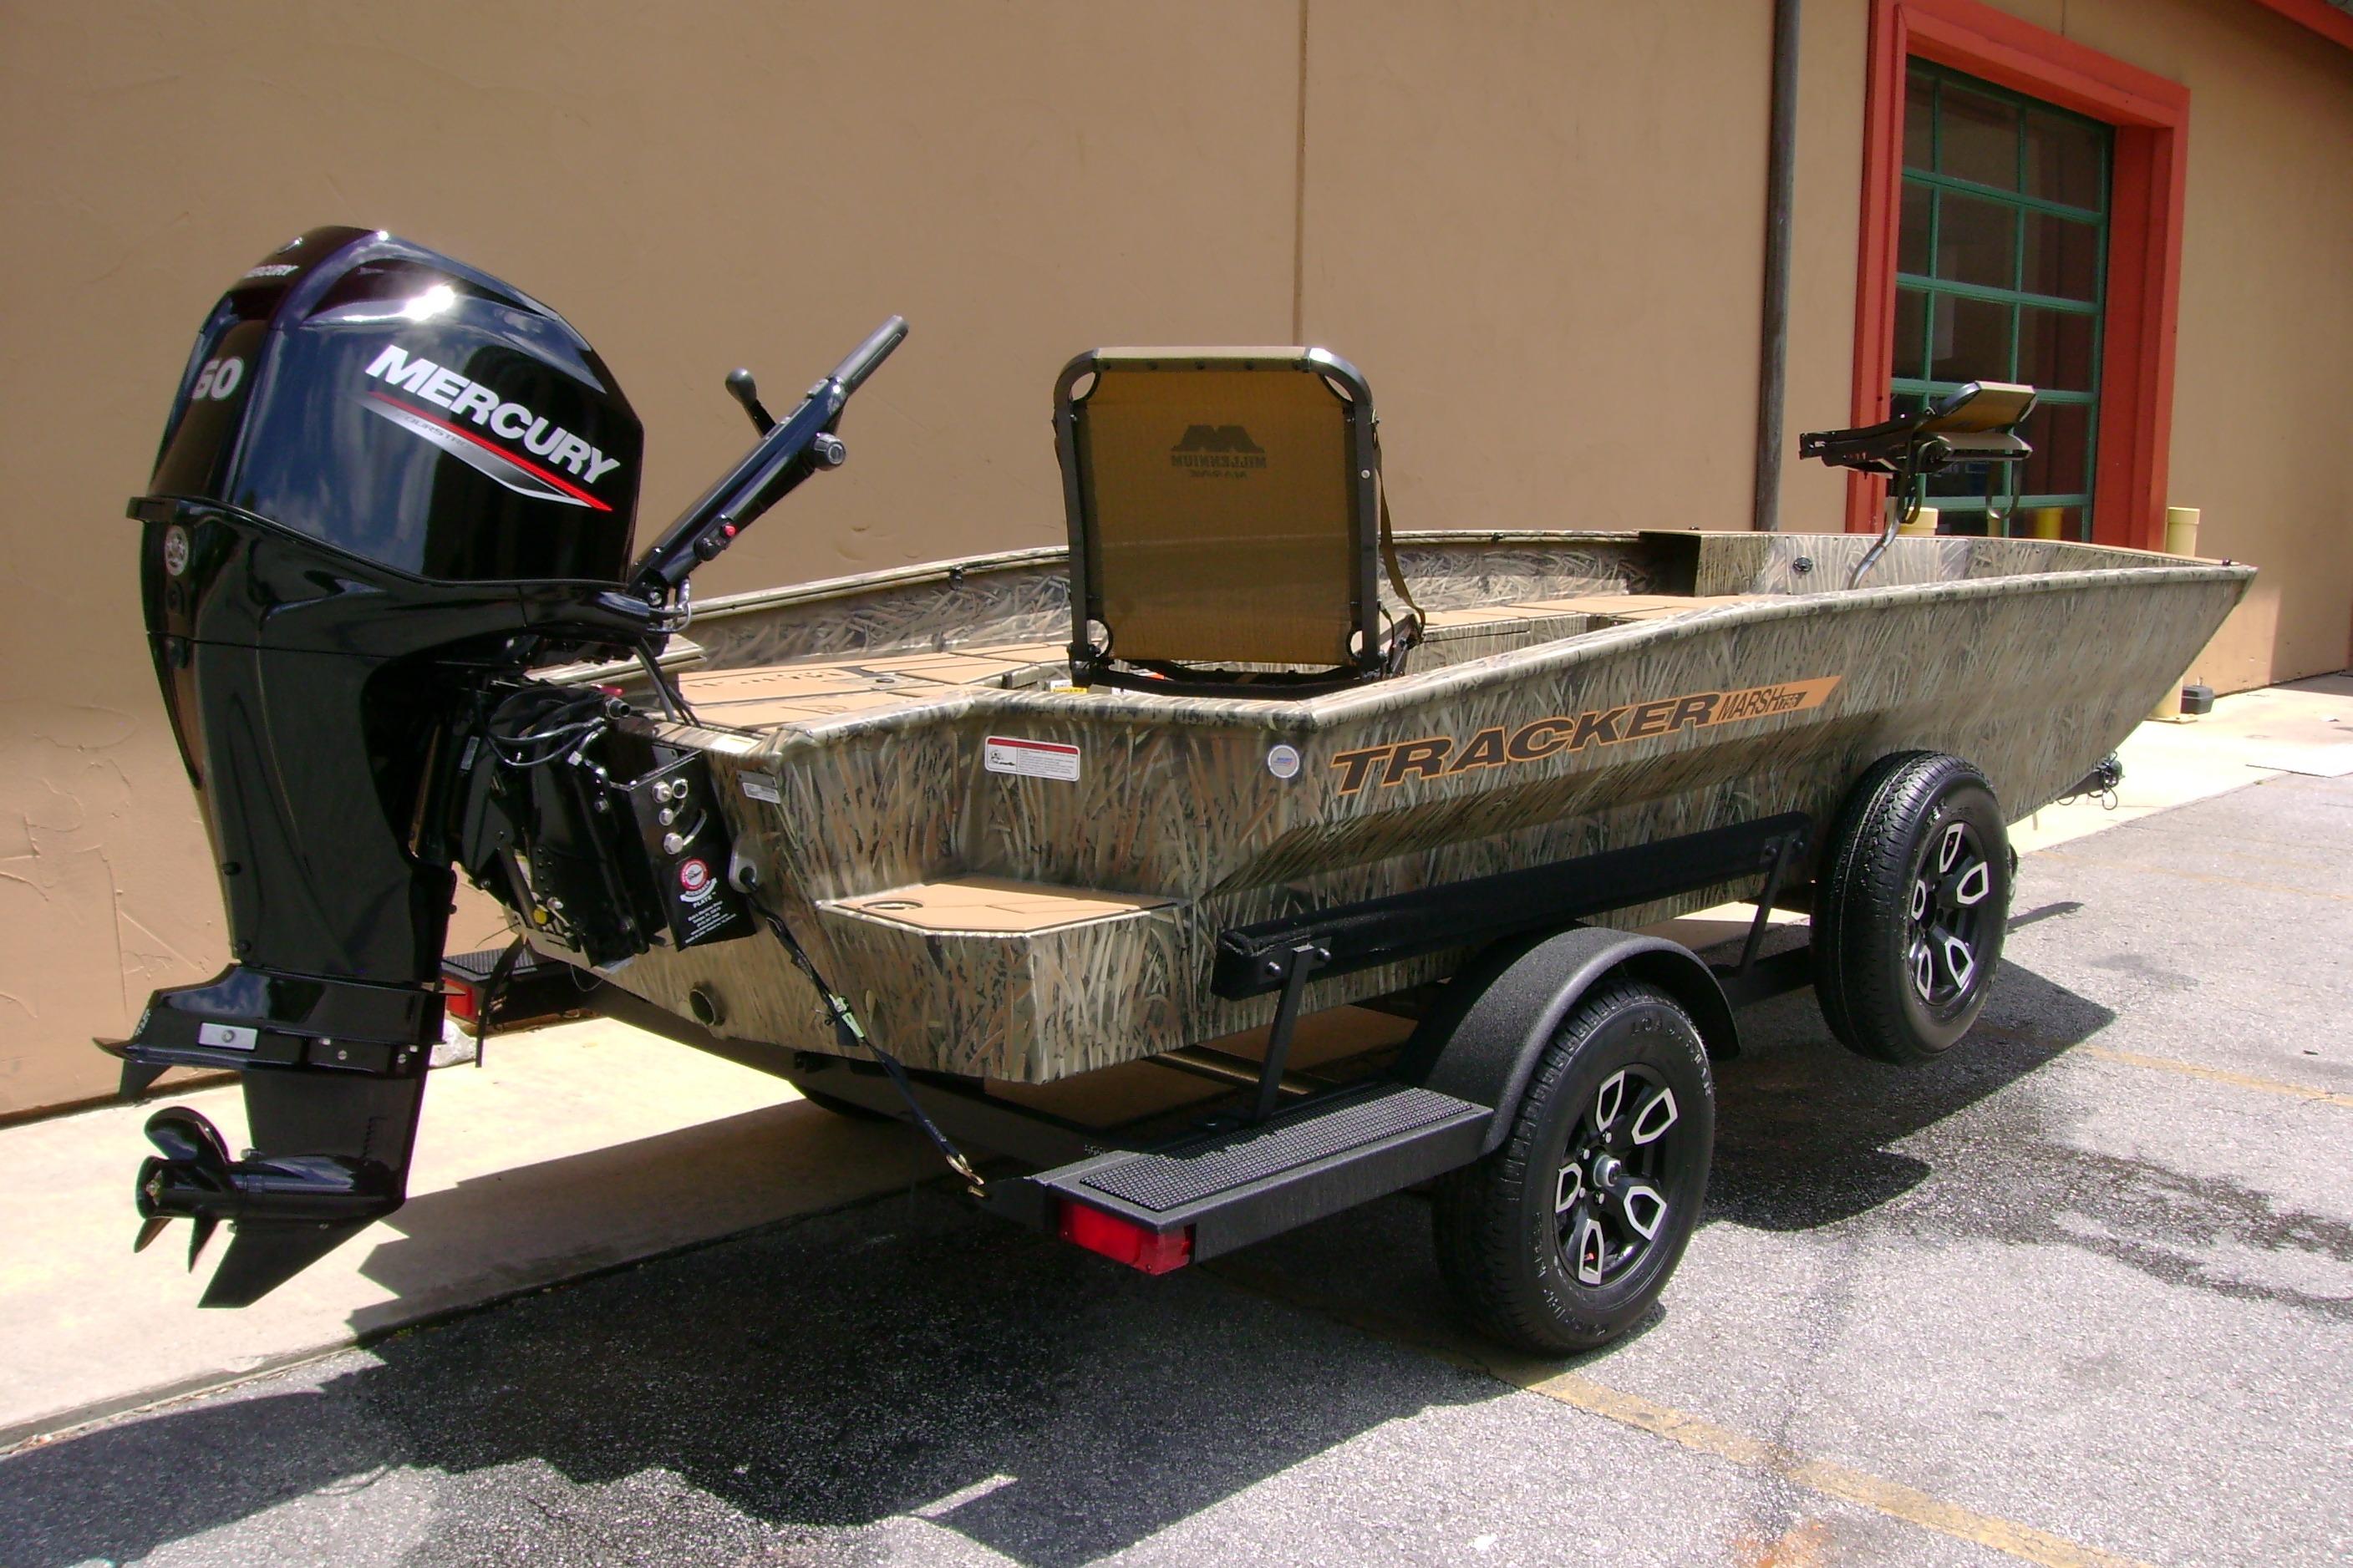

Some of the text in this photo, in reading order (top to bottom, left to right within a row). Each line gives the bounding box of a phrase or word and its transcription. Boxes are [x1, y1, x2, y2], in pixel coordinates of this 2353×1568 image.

[191, 356, 244, 400] 60
[365, 344, 621, 484] MERCURY
[1331, 687, 1786, 794] TRACKER MARSH
